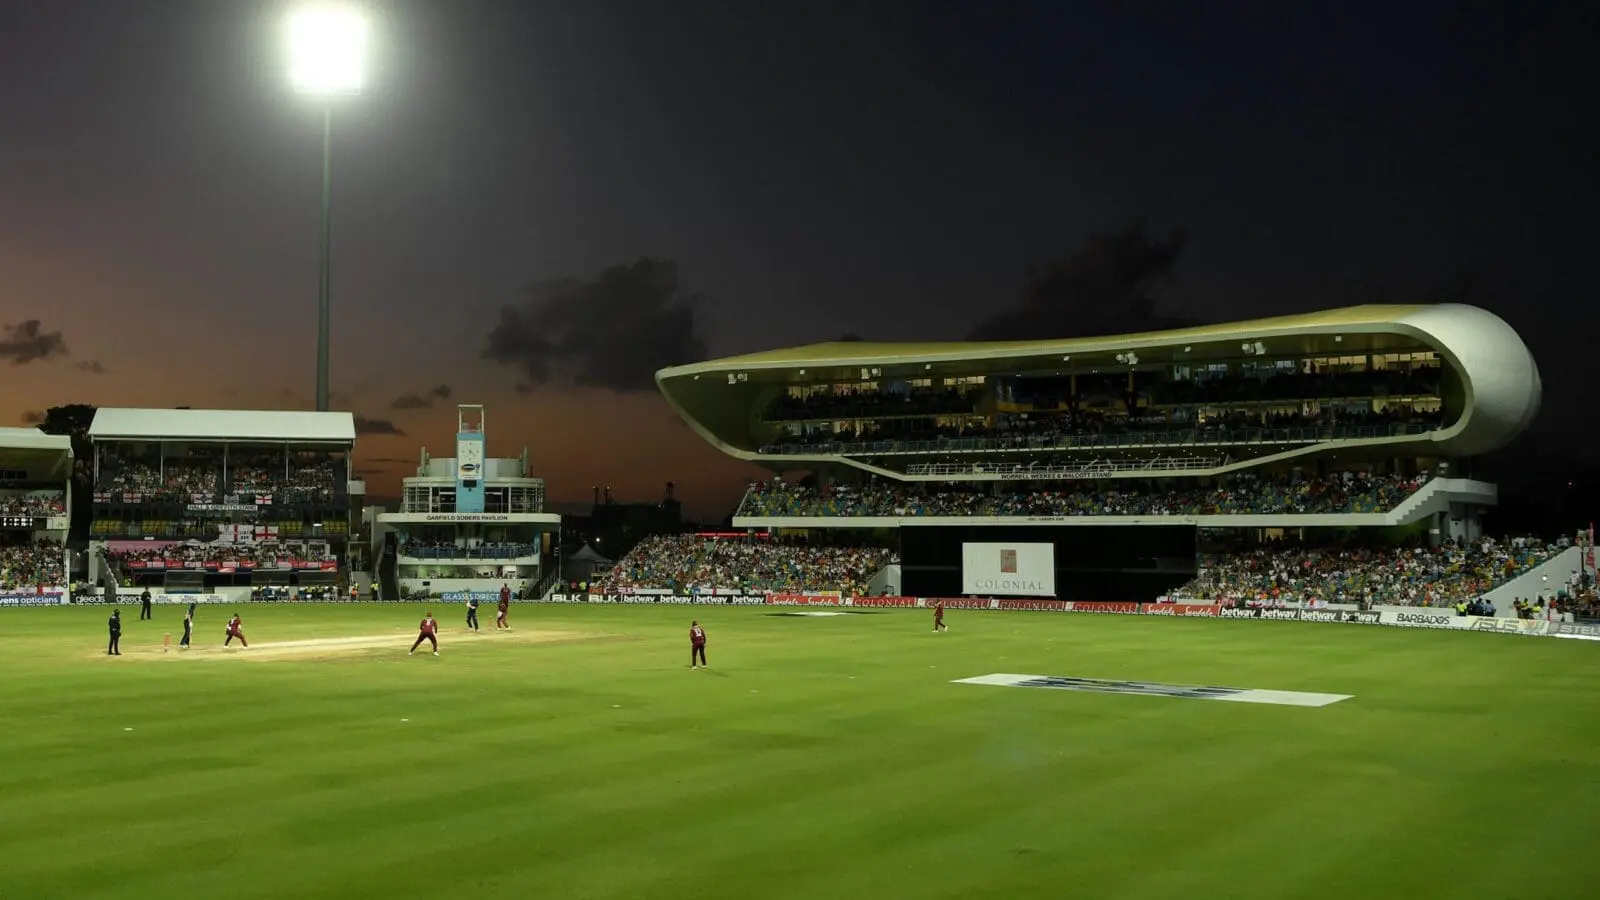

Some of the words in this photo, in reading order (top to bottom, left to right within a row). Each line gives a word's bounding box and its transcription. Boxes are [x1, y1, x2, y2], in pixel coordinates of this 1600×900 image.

[976, 580, 1044, 590] COLONIAL
[20, 596, 58, 604] opticians
[588, 594, 618, 603] BLK
[623, 594, 655, 603] betway
[660, 594, 692, 604] betway
[696, 595, 728, 604] betway
[732, 595, 764, 604] betway
[854, 599, 913, 607] COLONIAL
[926, 600, 987, 609] CLONIAL
[1000, 601, 1062, 610] COLONIAL
[1074, 603, 1134, 613] COLONIAL
[1221, 606, 1257, 617] betway
[1260, 607, 1297, 618] betway
[1301, 609, 1337, 621] betway
[1397, 613, 1451, 625] BARBADOS
